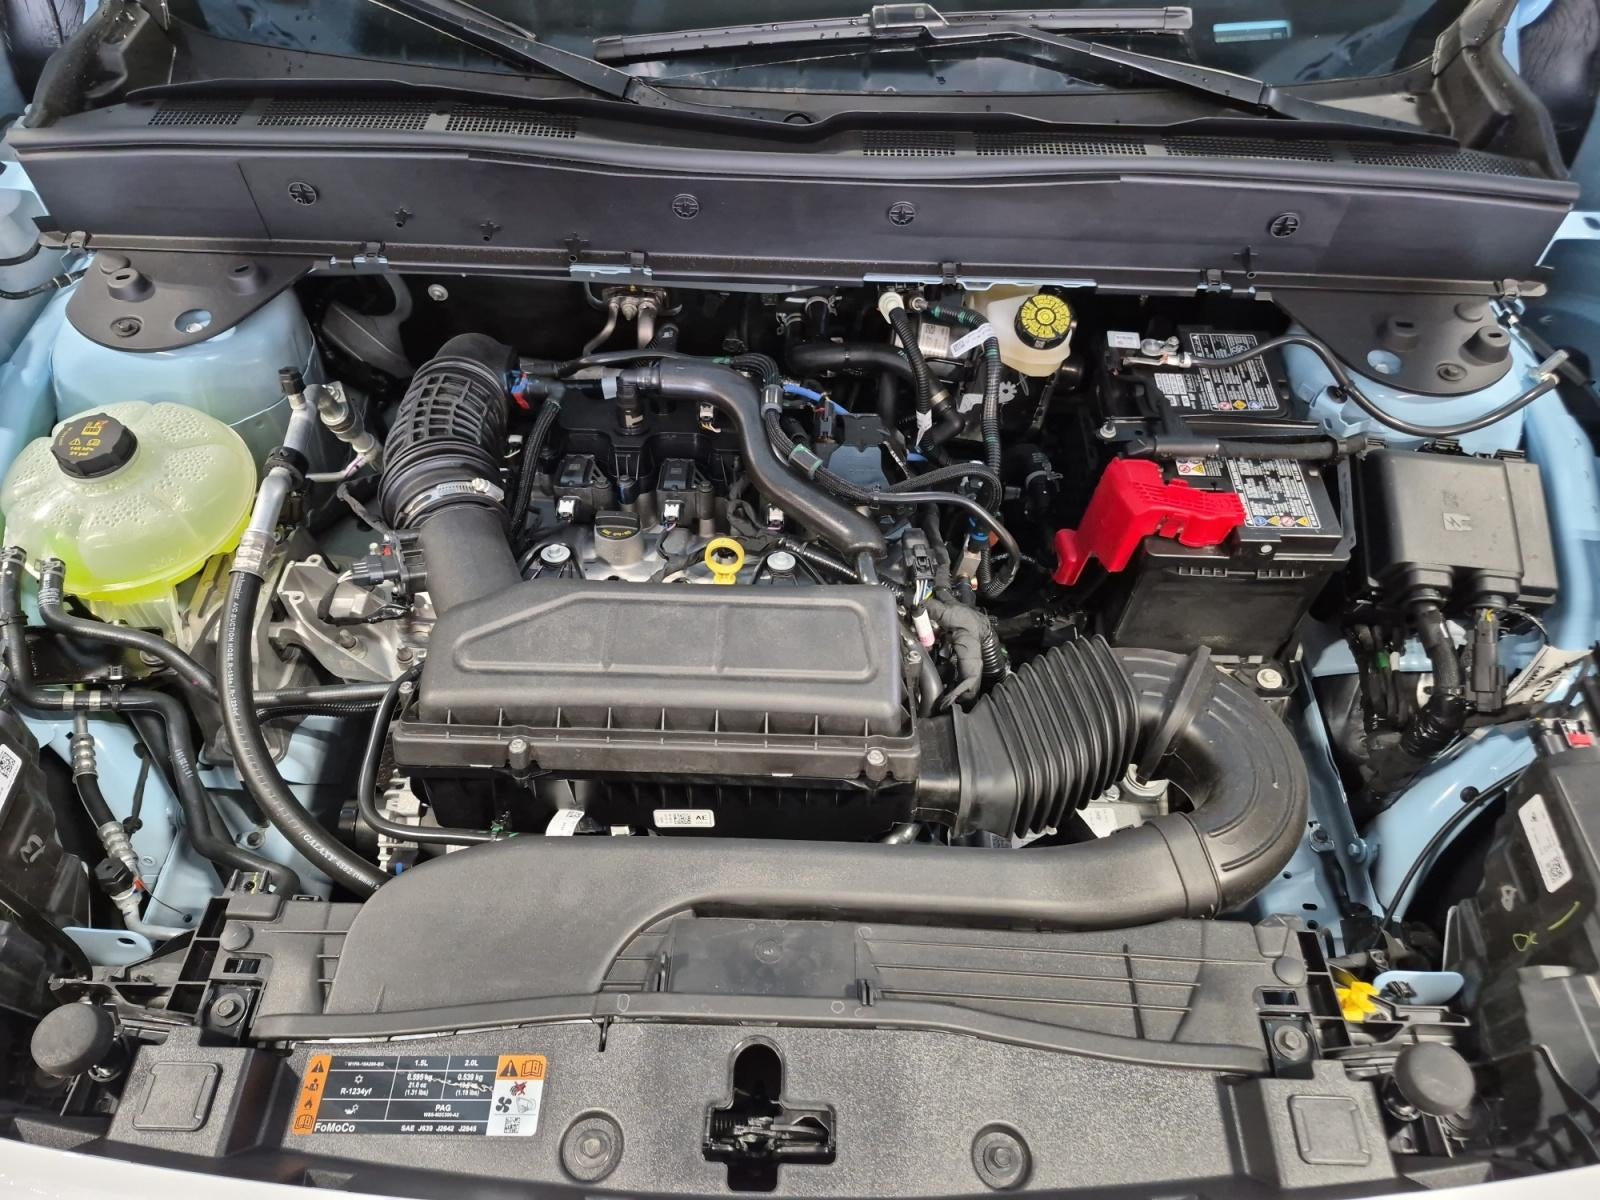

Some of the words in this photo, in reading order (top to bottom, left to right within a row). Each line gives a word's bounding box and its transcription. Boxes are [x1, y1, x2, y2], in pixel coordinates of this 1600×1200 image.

[228, 613, 237, 642] SUCTION
[303, 833, 337, 862] GALAXY
[414, 1059, 429, 1067] 1.5L
[464, 1059, 479, 1067] 2.0L
[424, 1073, 433, 1082] kg
[475, 1073, 484, 1082] kg
[340, 1087, 373, 1097] R-1234yf
[435, 1104, 452, 1112] PAG
[314, 1122, 356, 1133] FoMoCo
[400, 1124, 415, 1132] SAE
